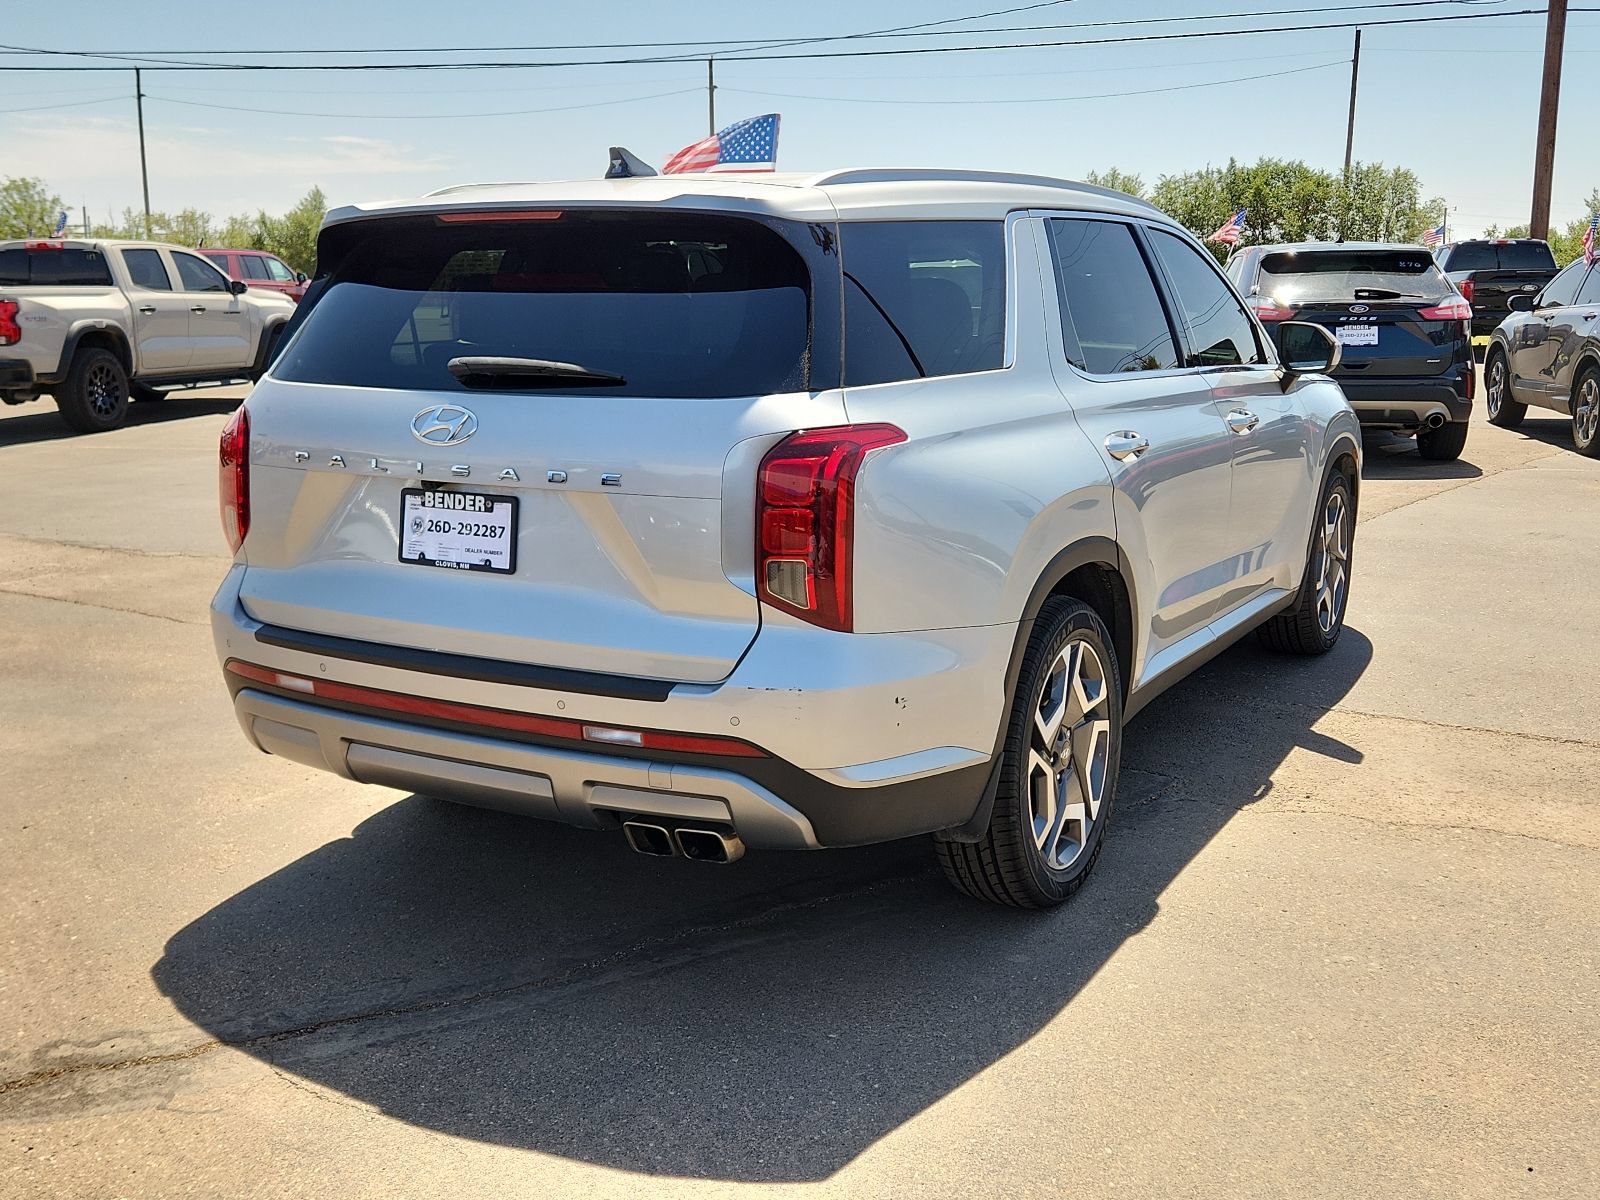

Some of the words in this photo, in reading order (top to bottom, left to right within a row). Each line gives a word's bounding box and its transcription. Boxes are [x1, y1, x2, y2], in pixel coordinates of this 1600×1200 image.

[295, 450, 622, 487] PALISADE
[424, 491, 485, 511] BENDER
[427, 519, 506, 539] 26D-292287
[435, 560, 458, 569] CLOVIS,
